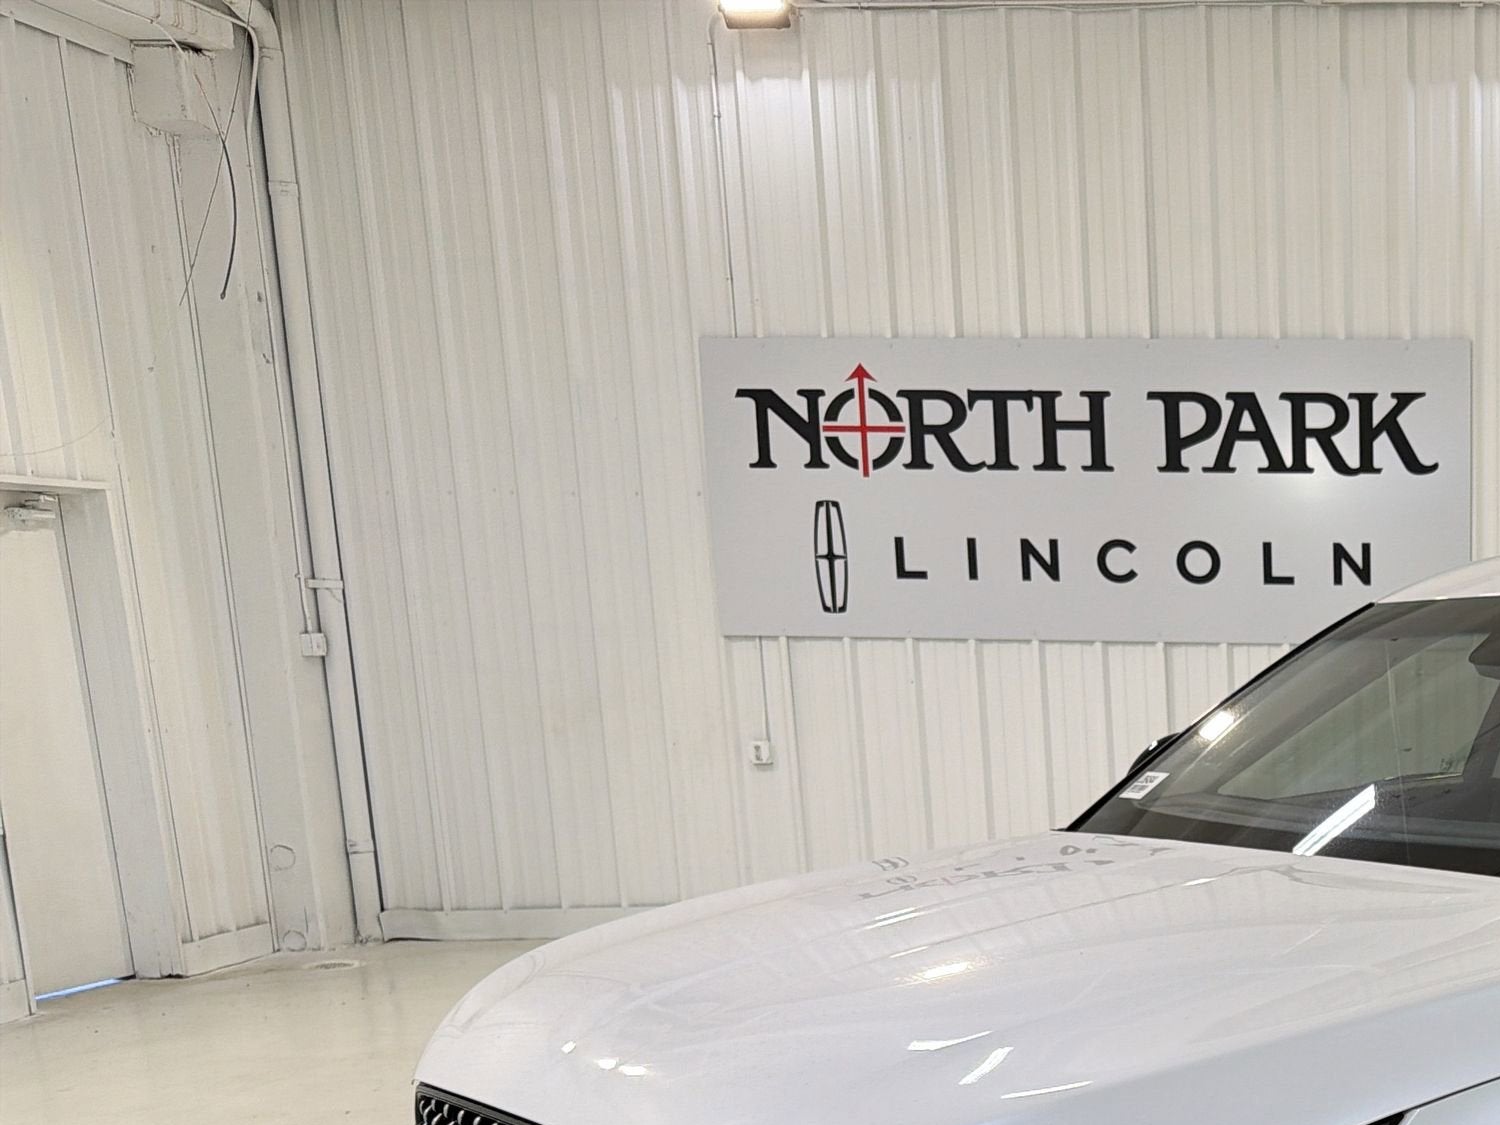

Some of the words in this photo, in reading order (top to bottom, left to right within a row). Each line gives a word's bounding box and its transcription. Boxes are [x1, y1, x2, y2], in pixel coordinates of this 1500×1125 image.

[734, 386, 1114, 473] NORTH
[1147, 391, 1440, 477] PARK
[892, 536, 1373, 586] LINCOLN
